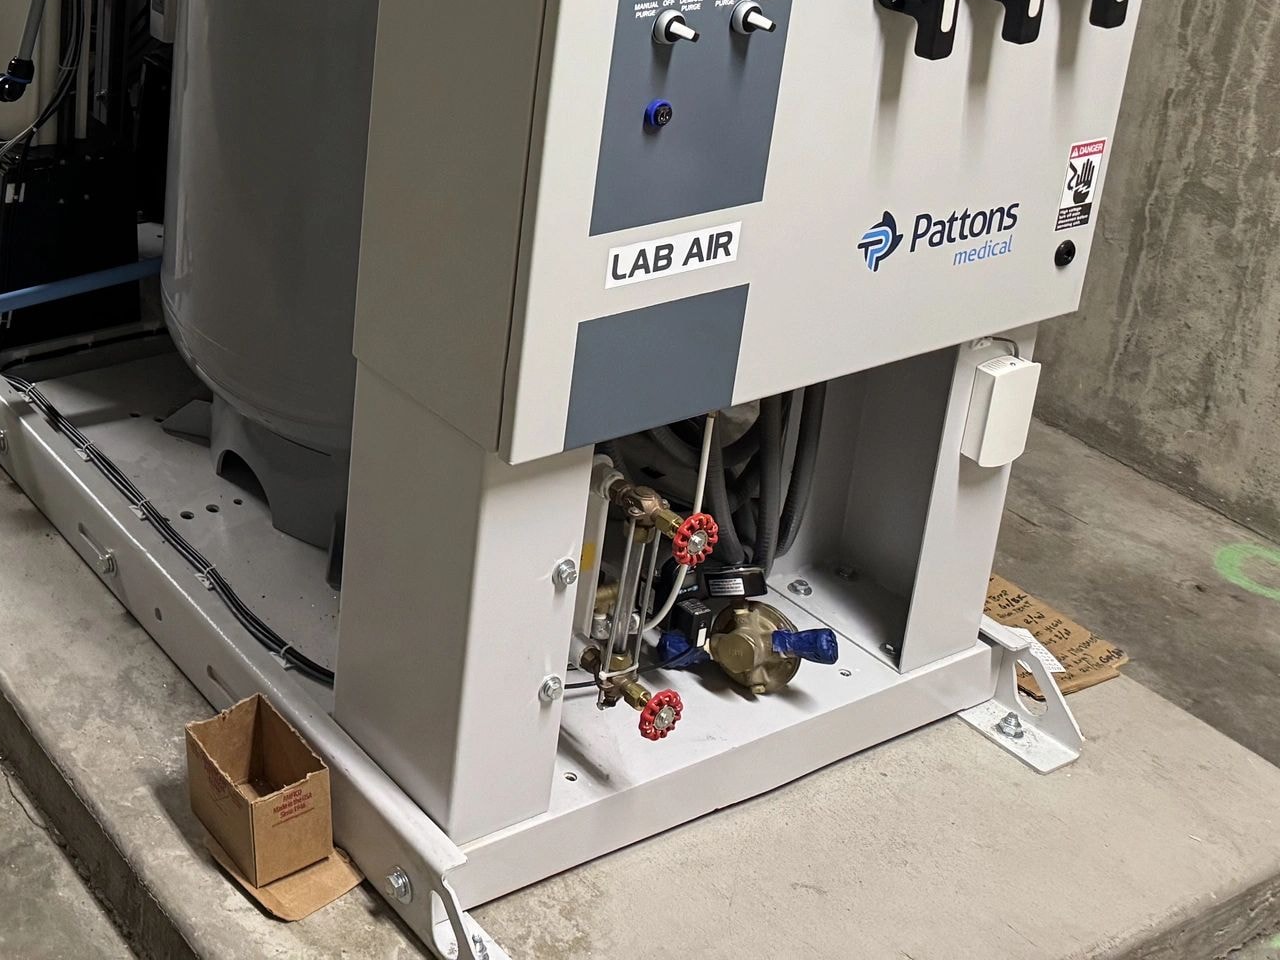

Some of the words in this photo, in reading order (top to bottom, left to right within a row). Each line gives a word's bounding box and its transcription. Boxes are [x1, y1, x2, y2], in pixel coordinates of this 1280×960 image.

[634, 1, 659, 11] MANUAL
[635, 10, 656, 18] PURGE
[681, 3, 702, 12] PURGE
[1080, 143, 1103, 154] DANGER
[910, 203, 1019, 252] Pattons
[612, 243, 674, 280] LAB
[682, 231, 733, 266] AIR
[953, 234, 1013, 266] medical
